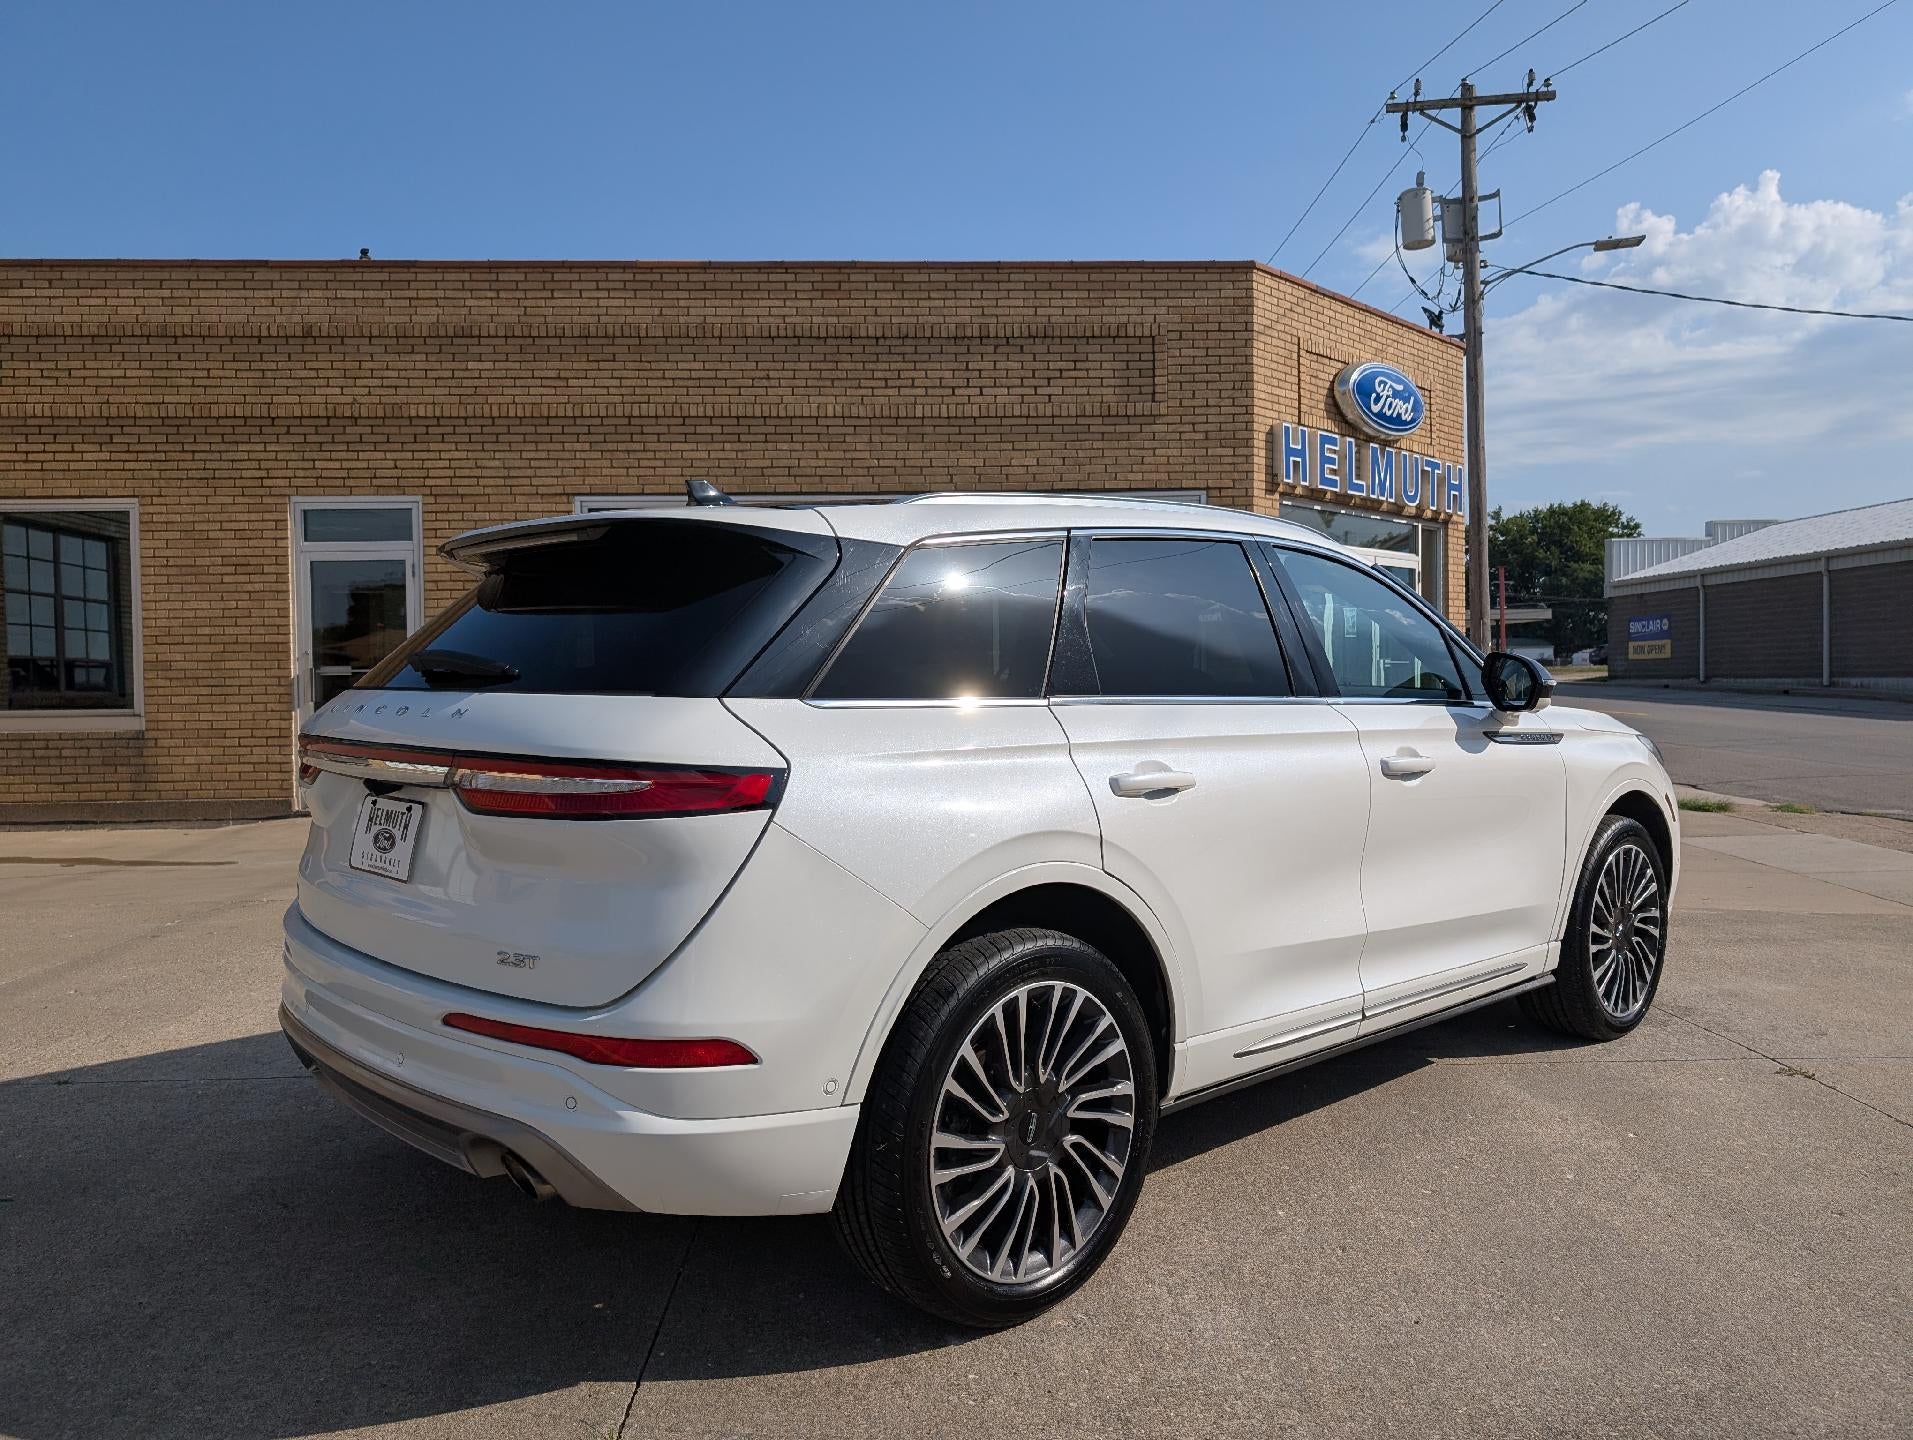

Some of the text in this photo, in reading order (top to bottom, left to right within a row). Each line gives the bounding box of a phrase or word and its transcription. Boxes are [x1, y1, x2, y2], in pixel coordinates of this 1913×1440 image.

[1370, 376, 1414, 422] Ford
[1282, 422, 1464, 515] HELMUTH
[1629, 619, 1661, 633] SINCLAIR
[1632, 644, 1646, 656] NOW
[365, 806, 412, 842] HELMUTH
